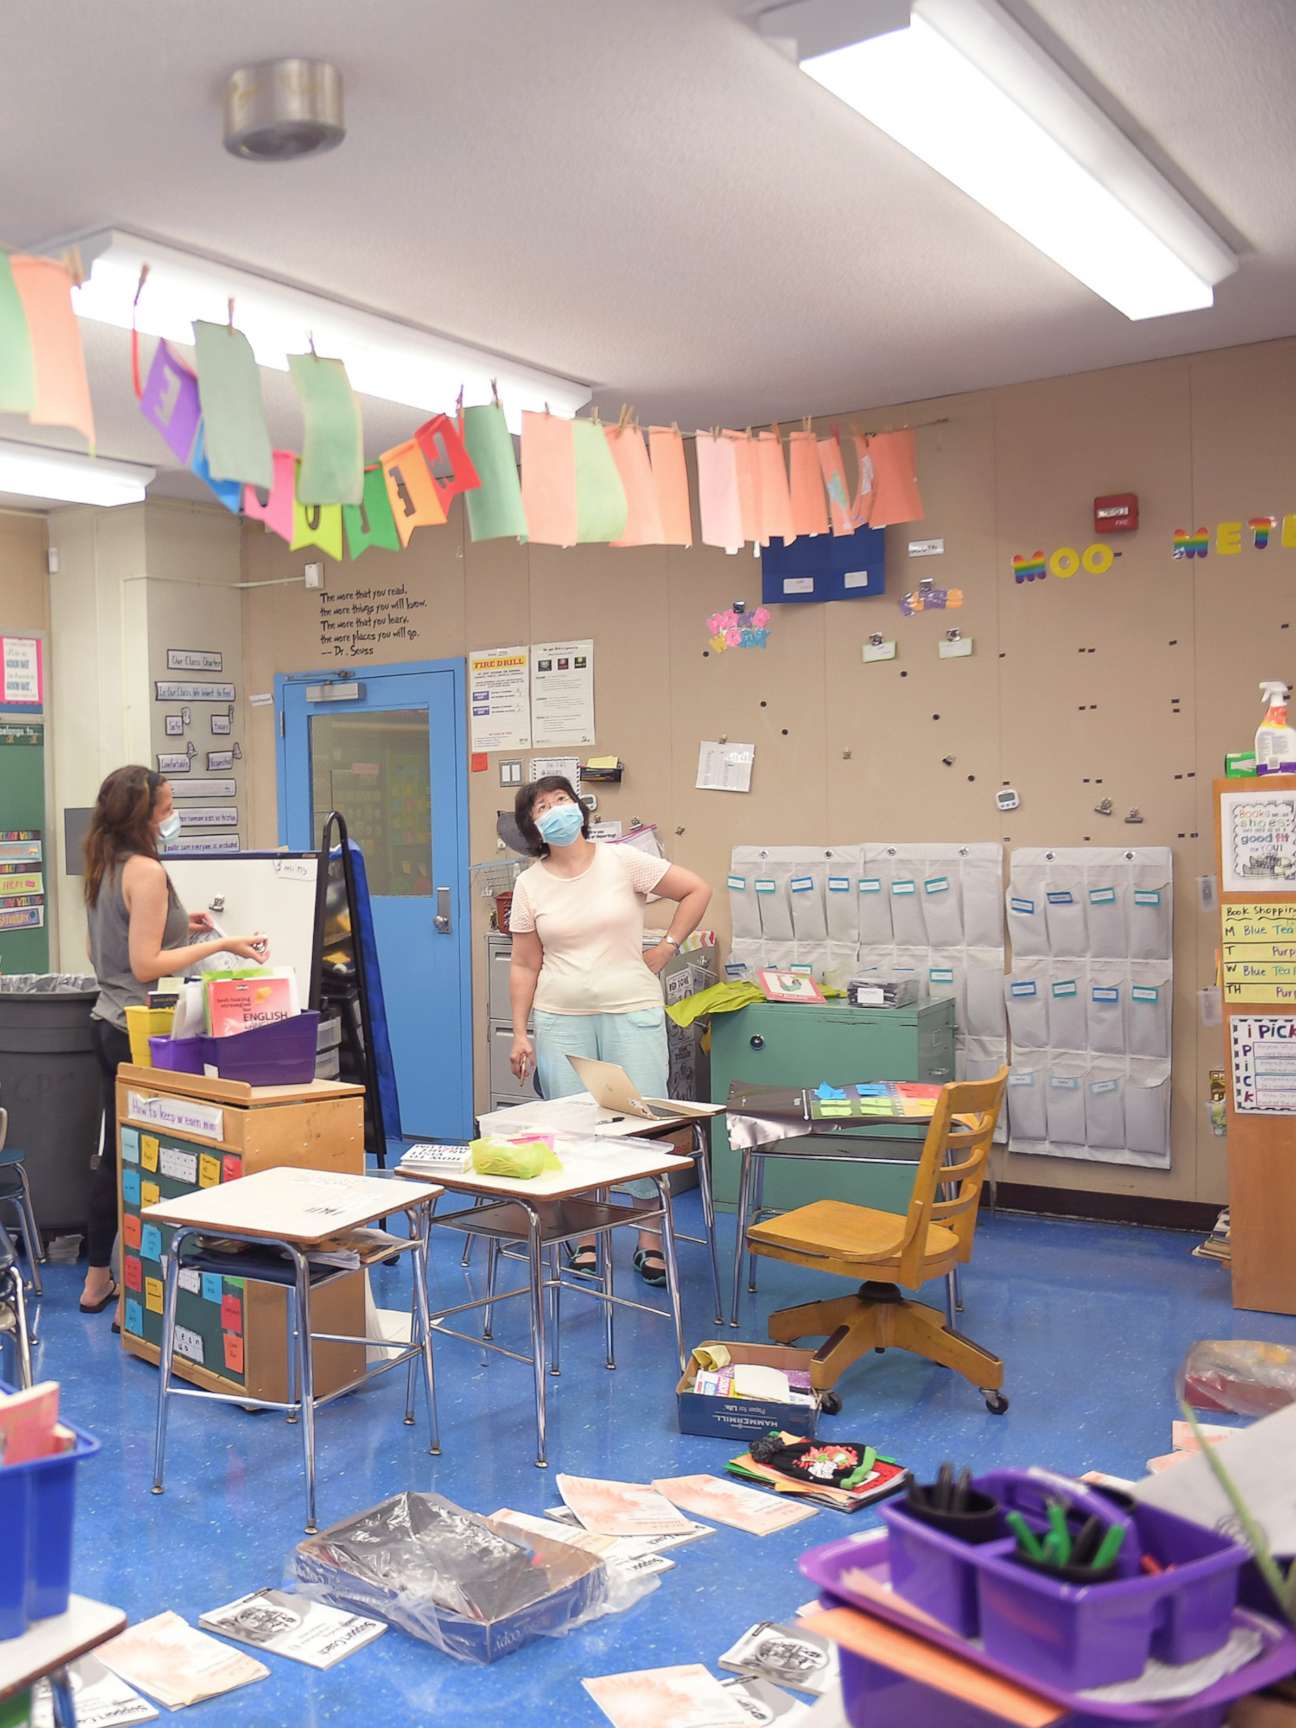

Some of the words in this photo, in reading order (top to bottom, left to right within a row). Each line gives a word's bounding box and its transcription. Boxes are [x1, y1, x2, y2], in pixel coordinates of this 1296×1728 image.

[356, 588, 371, 599] that
[373, 590, 386, 601] you
[352, 604, 374, 614] things
[376, 604, 389, 613] you
[391, 598, 404, 609] will
[356, 617, 371, 627] that
[373, 618, 386, 629] you
[352, 630, 376, 645] places
[350, 645, 374, 656] Seuss
[474, 660, 496, 669] FIRE
[499, 658, 524, 668] DRILL
[1241, 833, 1272, 845] good
[1226, 906, 1249, 917] Book
[1225, 926, 1235, 936] M
[1244, 925, 1267, 935] Blue
[1225, 945, 1235, 955] T
[1243, 965, 1266, 976] Blue
[1225, 984, 1241, 994] TH
[243, 1011, 288, 1022] ENGLISH
[716, 1415, 778, 1428] HAMMERMILL
